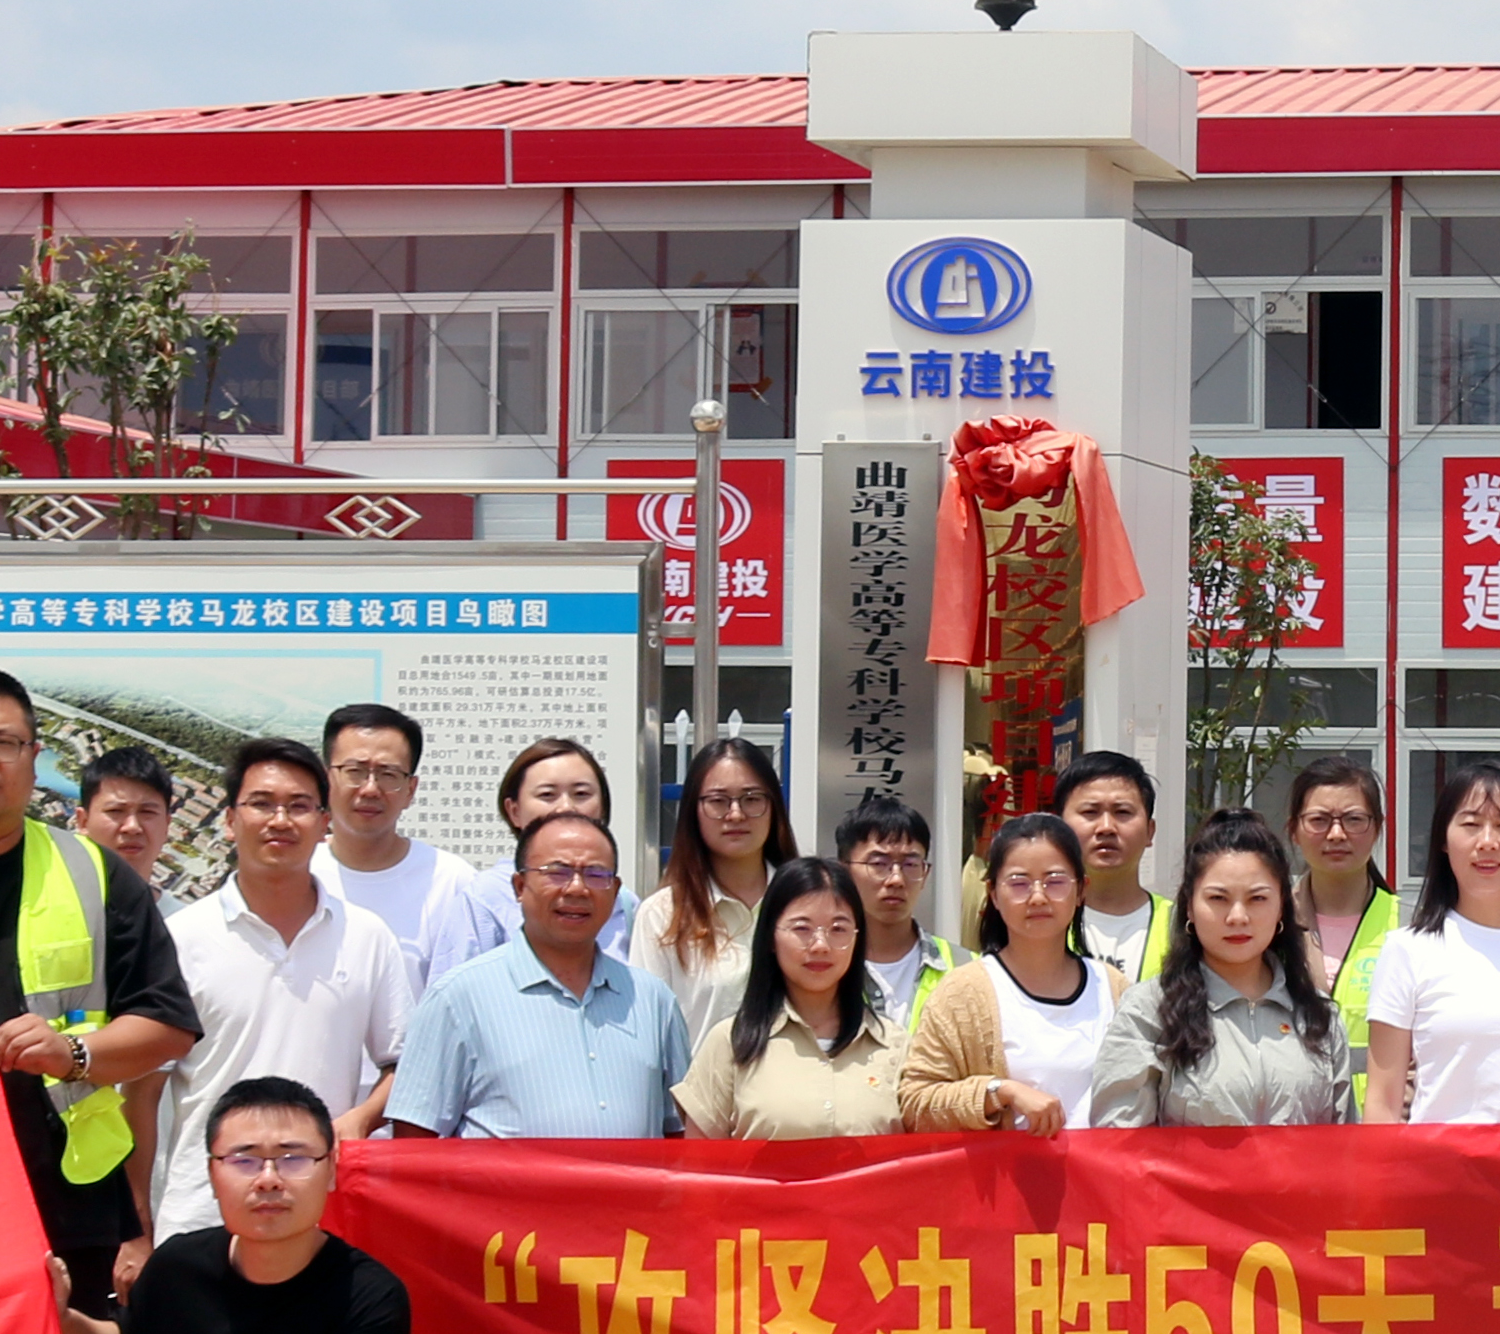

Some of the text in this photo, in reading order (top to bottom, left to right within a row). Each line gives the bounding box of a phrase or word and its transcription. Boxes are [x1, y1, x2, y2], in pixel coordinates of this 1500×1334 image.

[860, 349, 1055, 400] 云南建投
[981, 487, 1068, 827] 龙校区项目建
